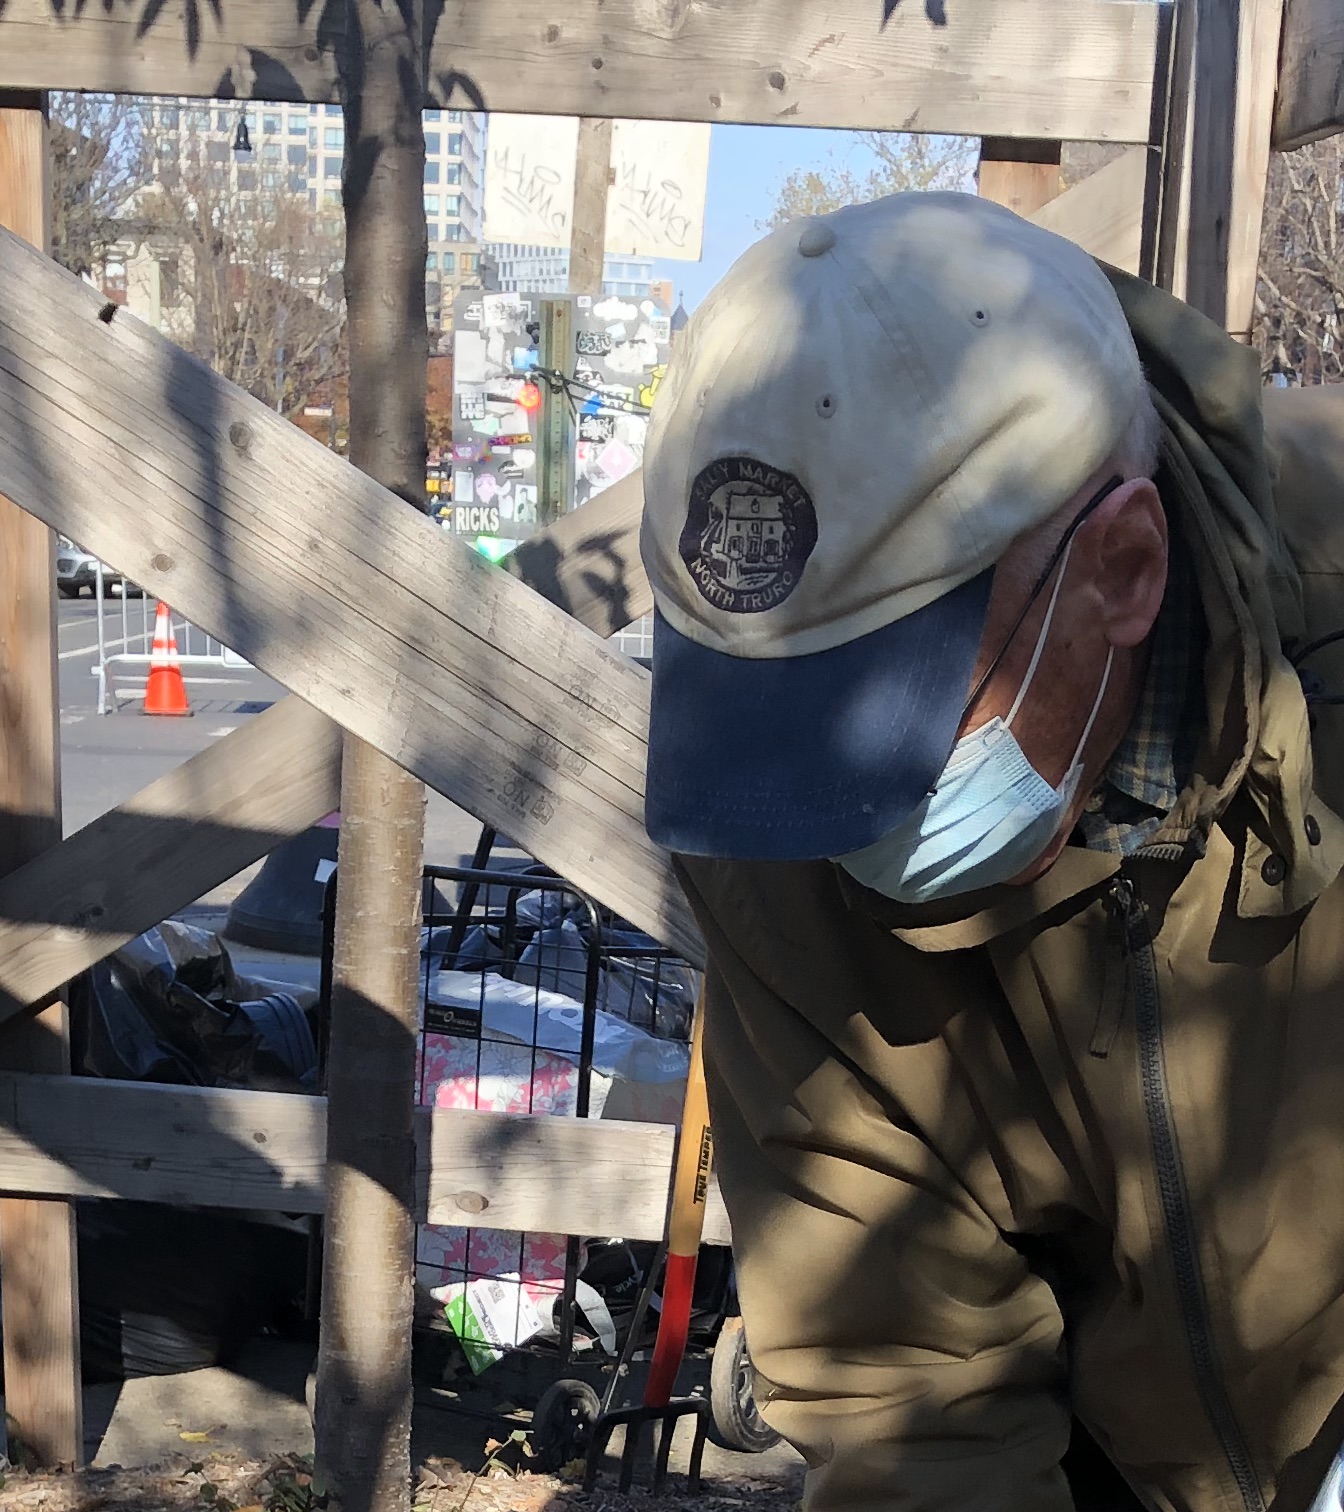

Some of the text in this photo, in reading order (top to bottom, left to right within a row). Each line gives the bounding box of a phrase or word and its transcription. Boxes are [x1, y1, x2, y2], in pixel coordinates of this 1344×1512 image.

[695, 461, 806, 508] SALTY MARKET
[455, 506, 500, 532] RICKS
[690, 556, 794, 609] NORTH TRURO
